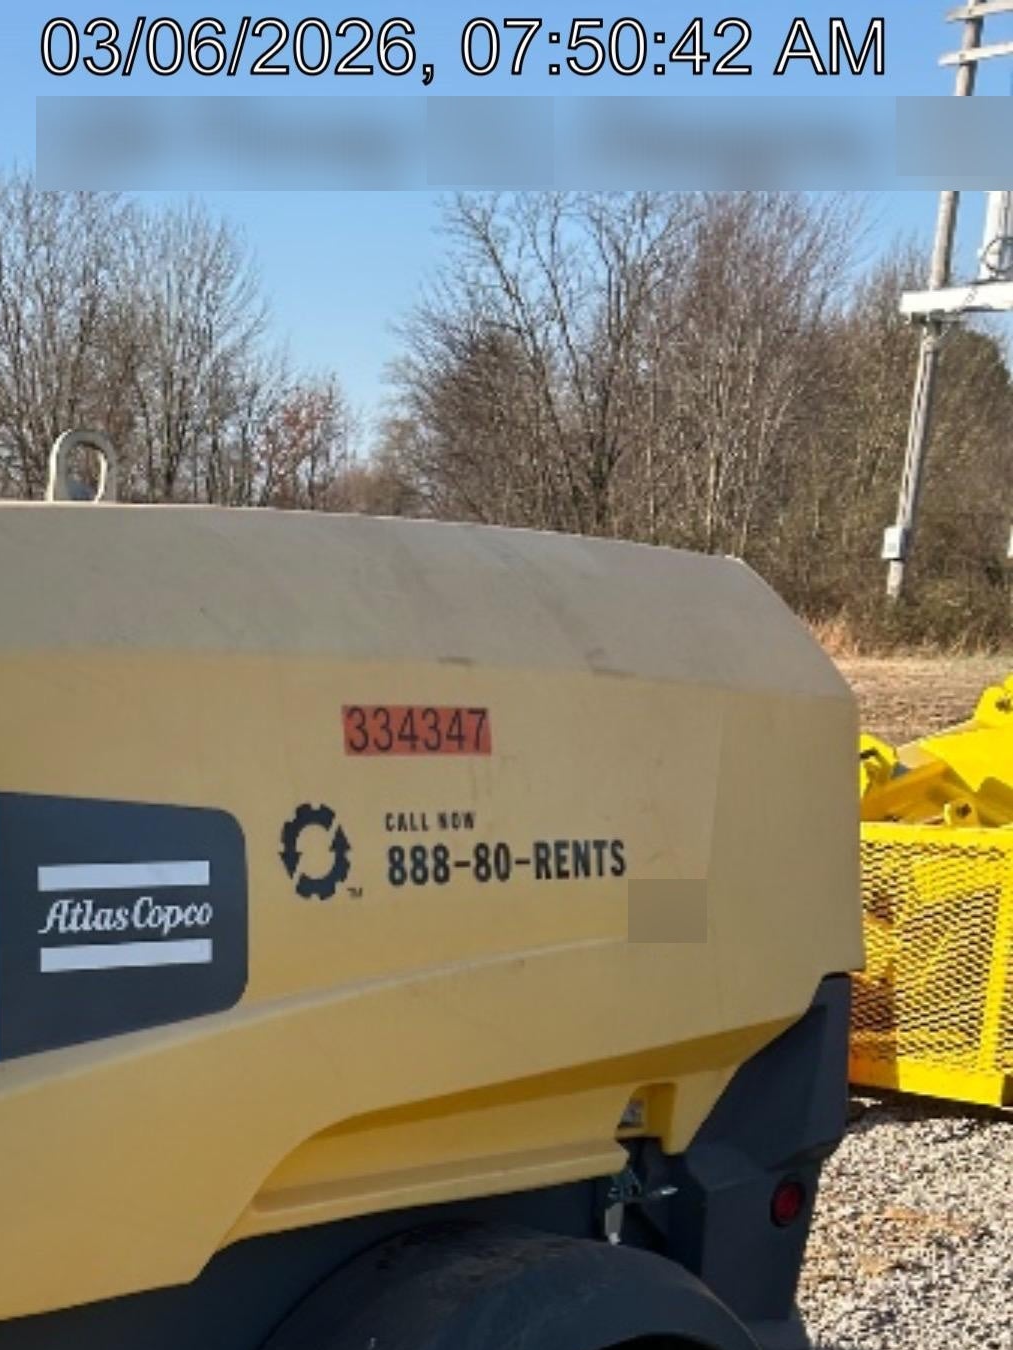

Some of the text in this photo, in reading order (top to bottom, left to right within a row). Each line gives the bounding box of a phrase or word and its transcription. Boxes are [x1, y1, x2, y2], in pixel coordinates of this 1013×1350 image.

[345, 706, 487, 752] 334347
[385, 811, 475, 832] CALL NOW
[388, 839, 627, 886] 888-80-RENTS
[38, 896, 214, 936] Atlas Copco
